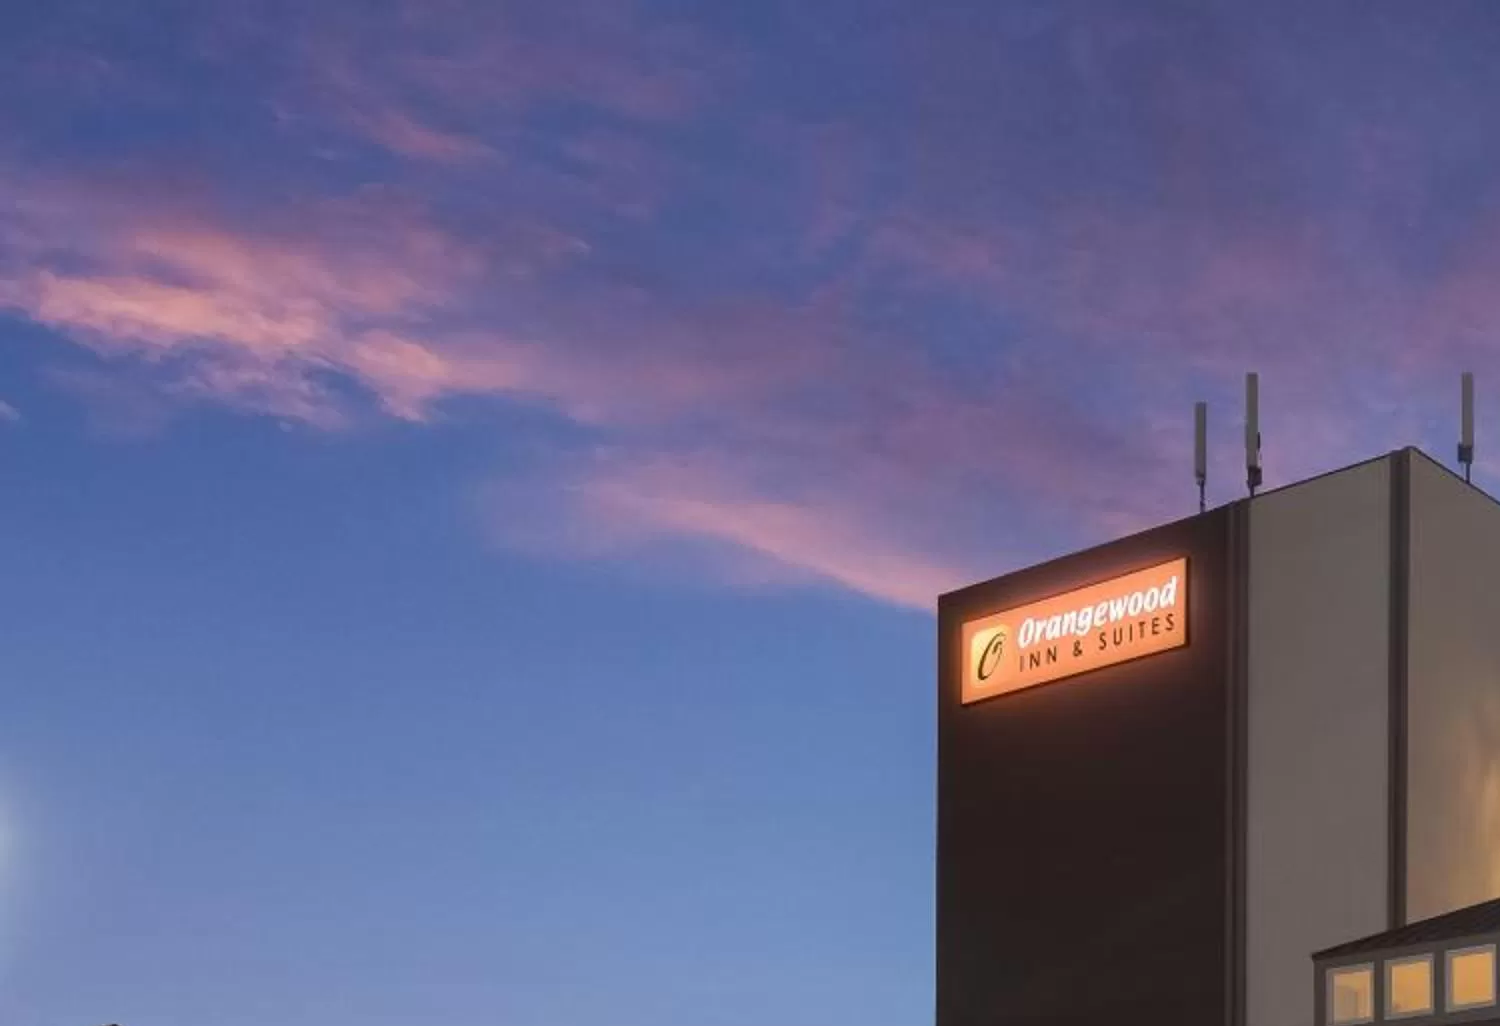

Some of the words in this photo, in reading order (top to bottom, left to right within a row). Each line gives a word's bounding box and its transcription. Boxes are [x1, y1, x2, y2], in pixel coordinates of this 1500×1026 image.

[1018, 575, 1179, 649] Orangewood
[1019, 646, 1057, 672] INN
[1073, 640, 1083, 657] &
[1099, 613, 1175, 650] SUITES
